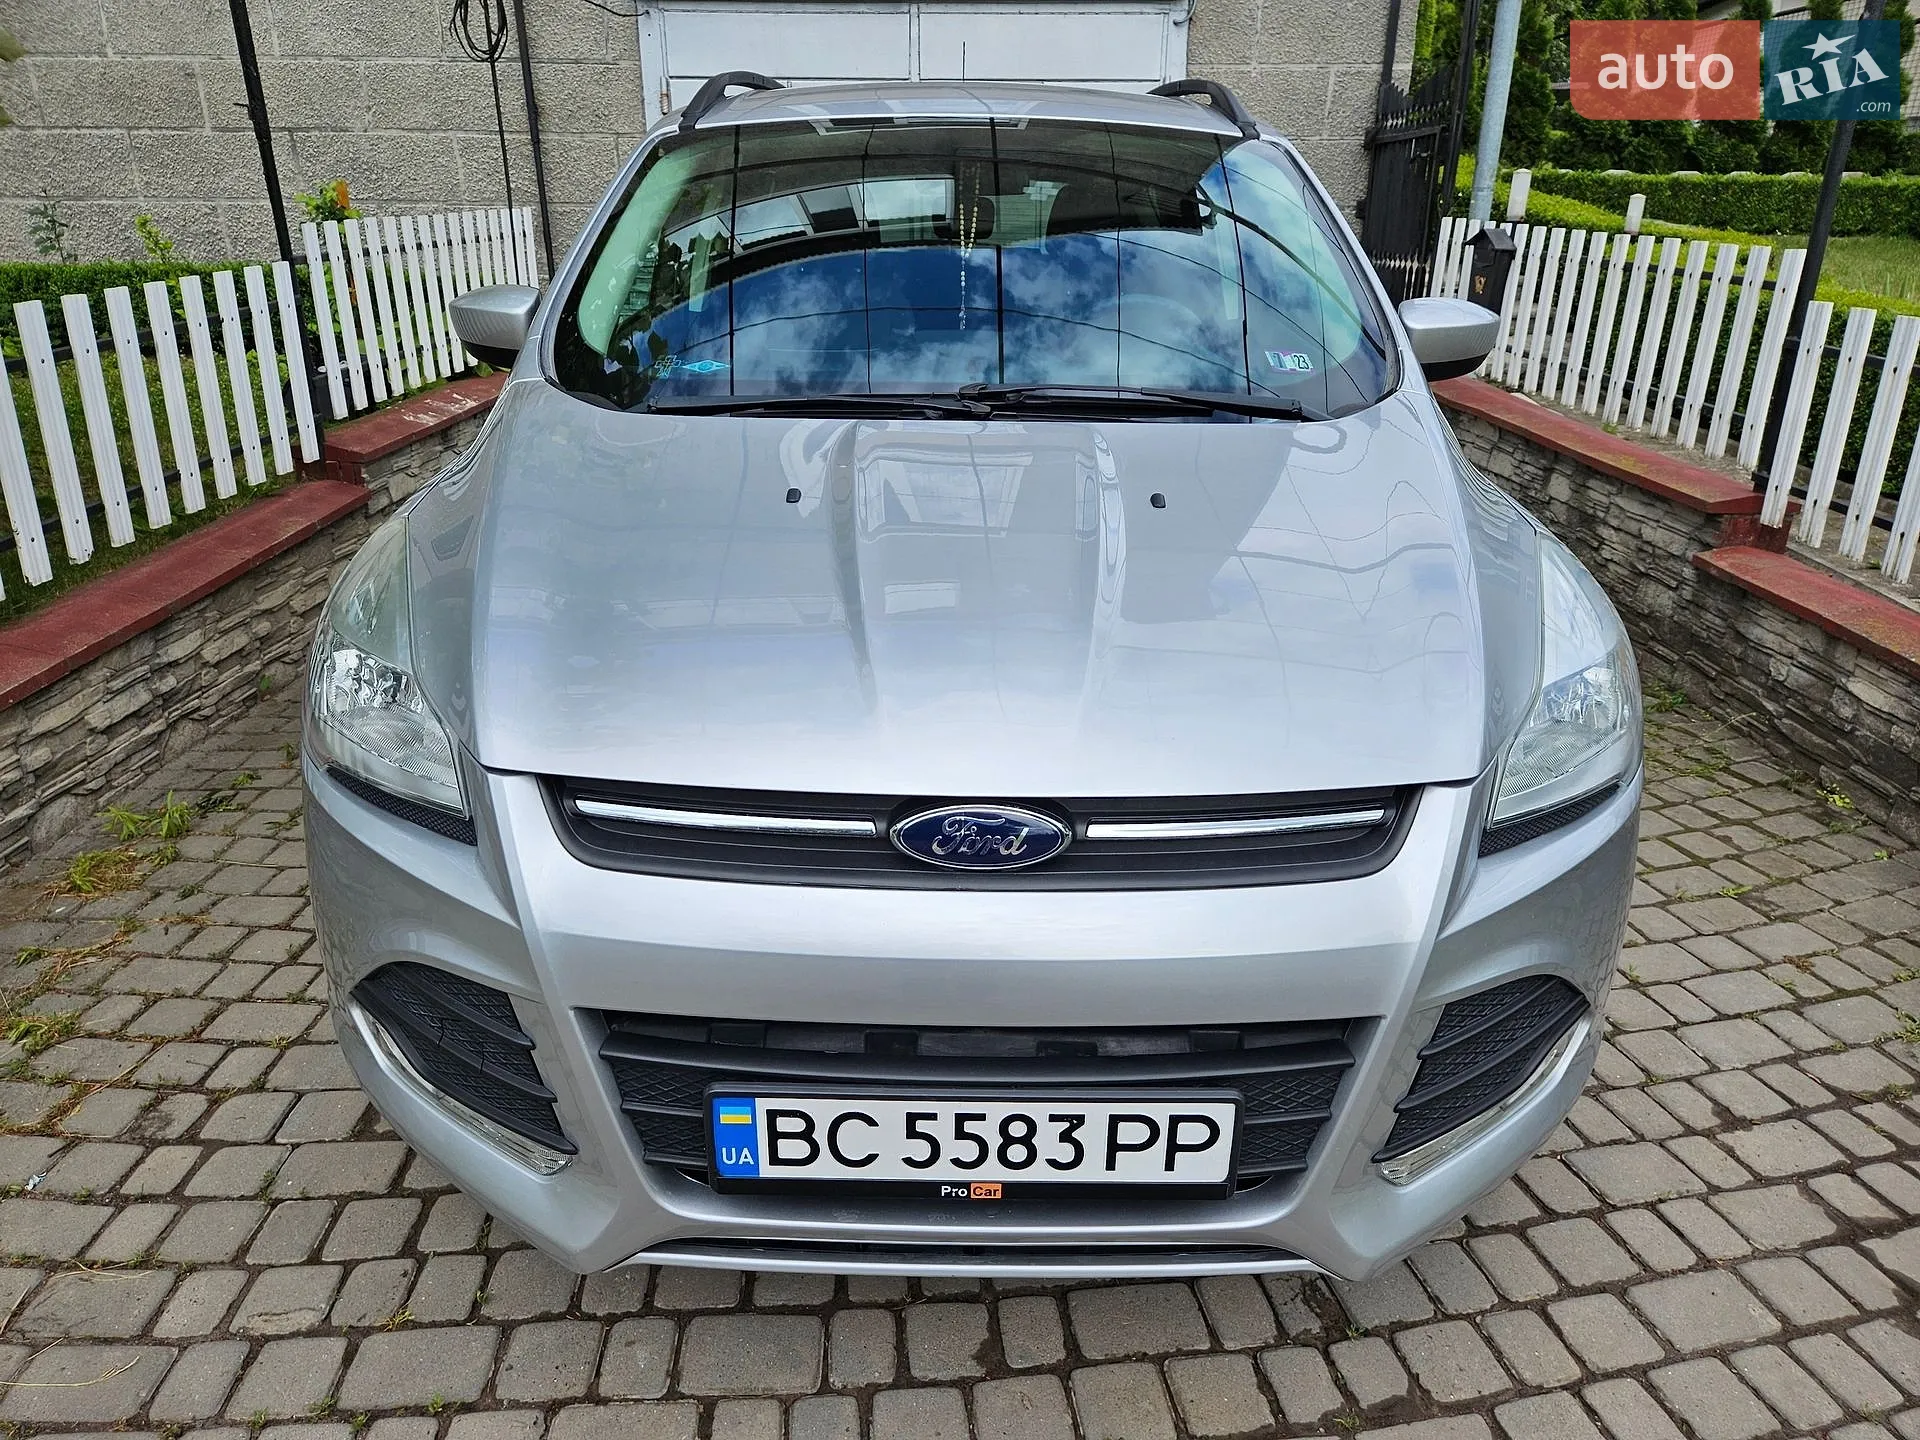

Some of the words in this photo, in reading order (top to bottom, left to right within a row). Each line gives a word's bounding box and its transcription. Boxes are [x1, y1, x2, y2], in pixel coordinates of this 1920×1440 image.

[1293, 354, 1310, 370] 23
[931, 816, 1029, 856] Ford
[765, 1109, 880, 1168] BC
[901, 1111, 1086, 1172] 5583
[1105, 1114, 1221, 1173] PP
[721, 1147, 755, 1166] UA
[941, 1185, 968, 1197] Pro
[973, 1186, 1000, 1197] Car
